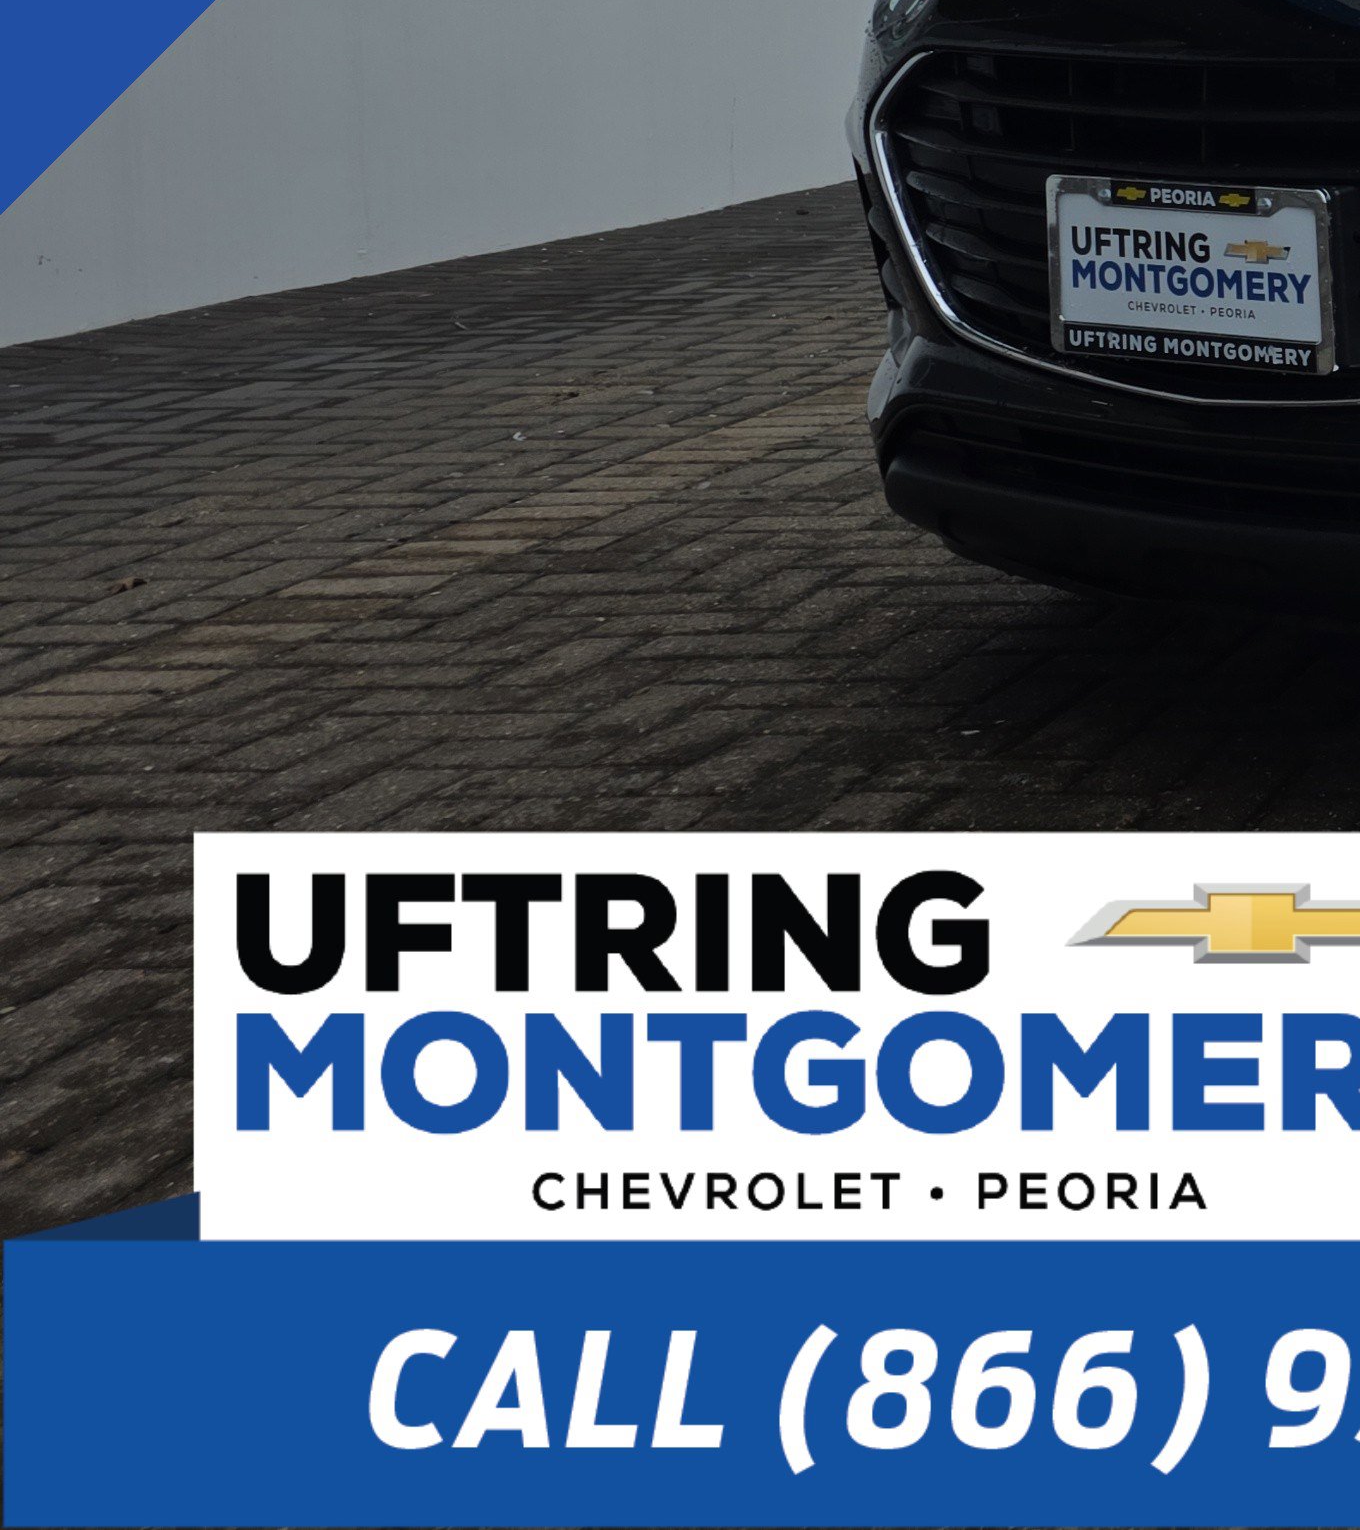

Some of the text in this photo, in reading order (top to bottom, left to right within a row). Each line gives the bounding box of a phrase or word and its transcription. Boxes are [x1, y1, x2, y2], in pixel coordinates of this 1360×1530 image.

[1150, 187, 1217, 207] PEORIA
[1070, 225, 1211, 264] UFTRING
[1071, 258, 1312, 305] MONTGOMERY
[1127, 300, 1257, 320] CHEVROLET PEORIA
[1069, 328, 1312, 367] UFTRING MONTGOMERY
